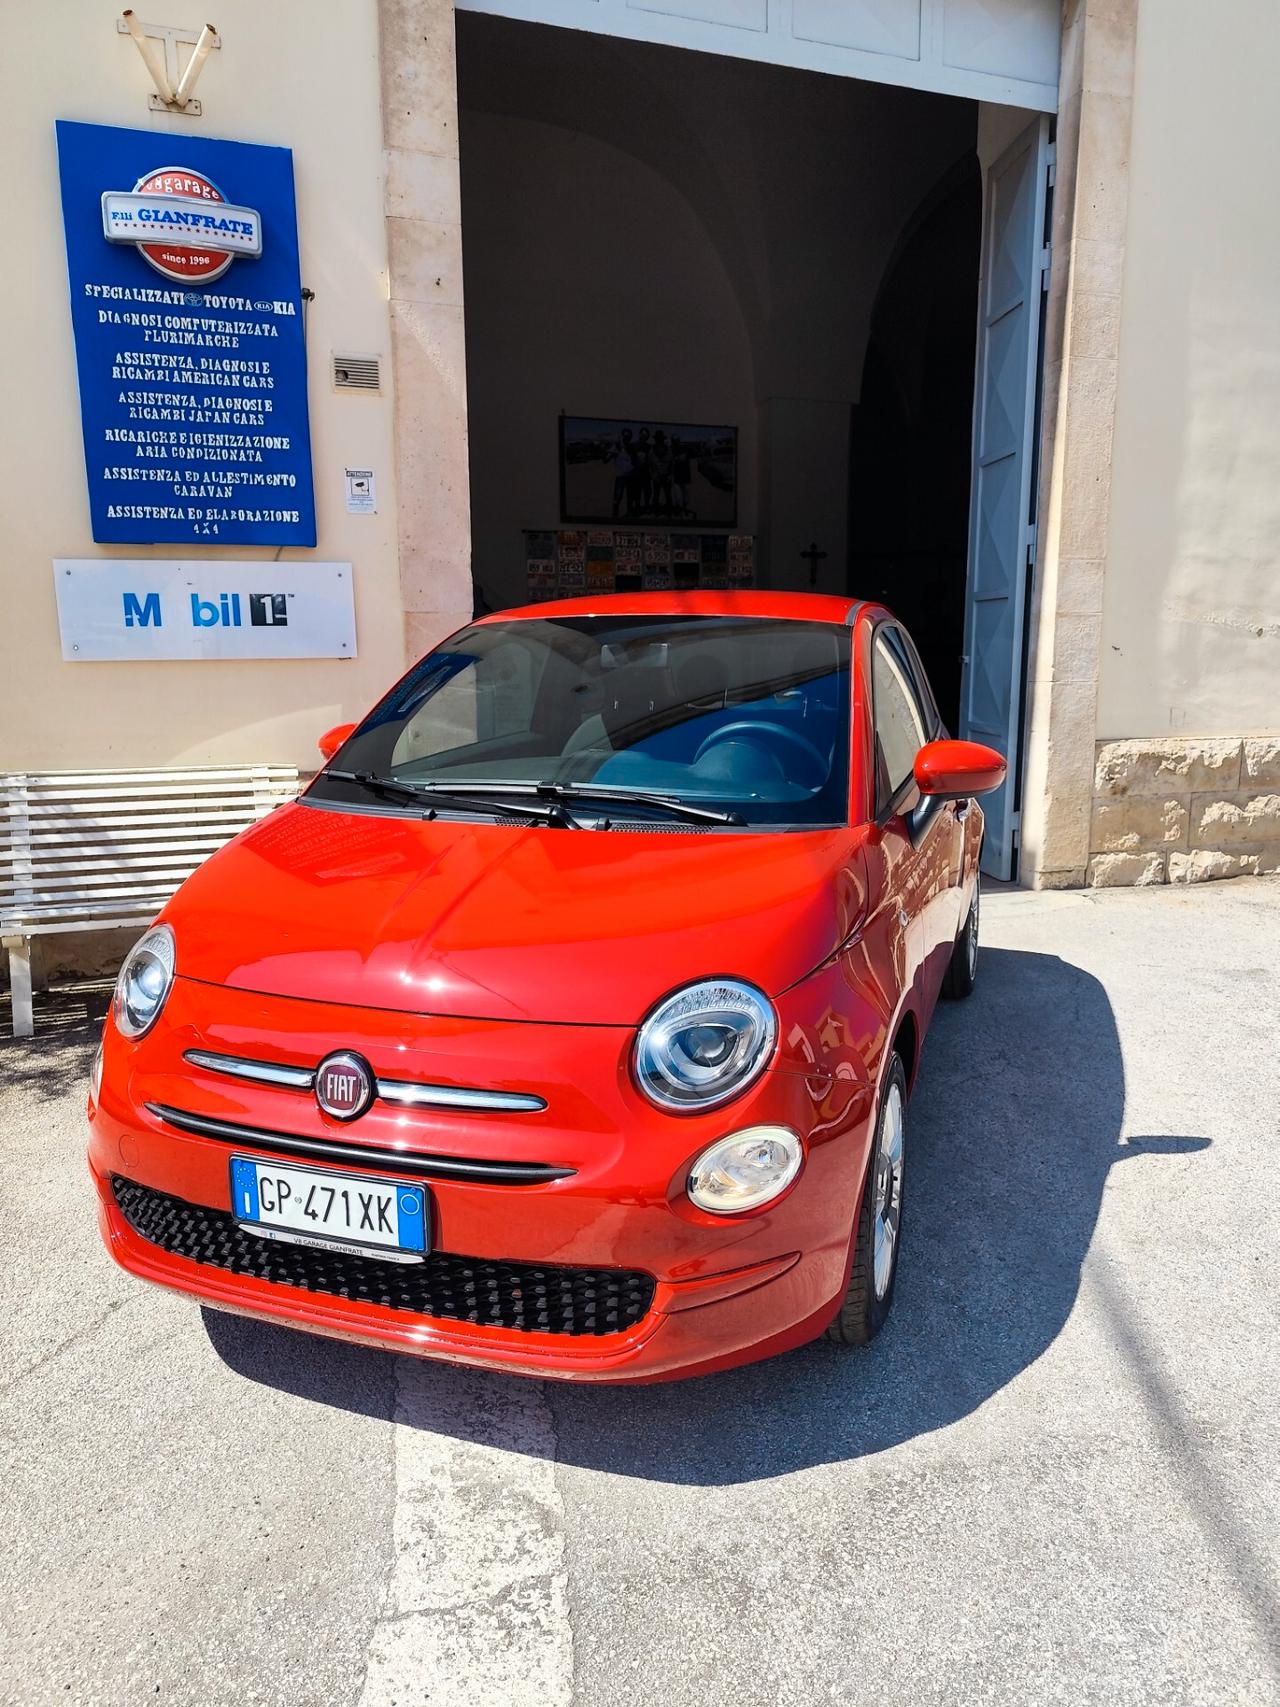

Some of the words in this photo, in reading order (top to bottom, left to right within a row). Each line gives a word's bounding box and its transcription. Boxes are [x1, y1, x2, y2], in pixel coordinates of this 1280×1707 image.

[138, 208, 253, 236] GIANFRATE
[162, 252, 187, 265] since
[189, 255, 210, 266] 1996
[84, 284, 184, 306] SPECIALIZZATI
[203, 295, 252, 312] TOYOTA
[273, 301, 296, 316] KIA
[98, 310, 162, 328] DIAGNOSI
[164, 316, 278, 337] COMPUTERIZZATA
[144, 330, 240, 348] PLURIMARCHE
[115, 352, 198, 370] ASSISTENZA,
[200, 358, 260, 374] DIAGNOSI
[261, 361, 270, 374] E
[112, 366, 170, 382] RICAMBI
[172, 370, 240, 387] AMERICAN
[242, 373, 275, 389] CARS
[118, 391, 201, 409] ASSISTENZA,
[203, 397, 262, 412] DIAGNOSI
[264, 399, 273, 413] E
[129, 407, 186, 422] RICAMBI
[189, 410, 230, 424] JAPAN
[233, 412, 265, 426] CARS
[105, 429, 177, 444] RICARICHE
[179, 432, 187, 444] E
[189, 432, 290, 450] IGIENIZZAZIONE
[135, 445, 168, 459] ARIA
[171, 447, 263, 463] CONDIZIONATA
[103, 467, 181, 482] ASSISTENZA
[184, 471, 200, 482] ED
[203, 472, 296, 488] ALLESTIMENTO
[173, 485, 233, 498] CARAVAN
[107, 505, 184, 520] ASSISTENZA
[187, 507, 203, 520] ED
[206, 508, 300, 523] ELABORAZIONE
[327, 1073, 357, 1102] FIAT
[259, 1176, 291, 1215] GP
[303, 1185, 394, 1234] 471XK
[303, 1239, 328, 1250] GARAGE
[329, 1244, 364, 1256] GIANFRATE
